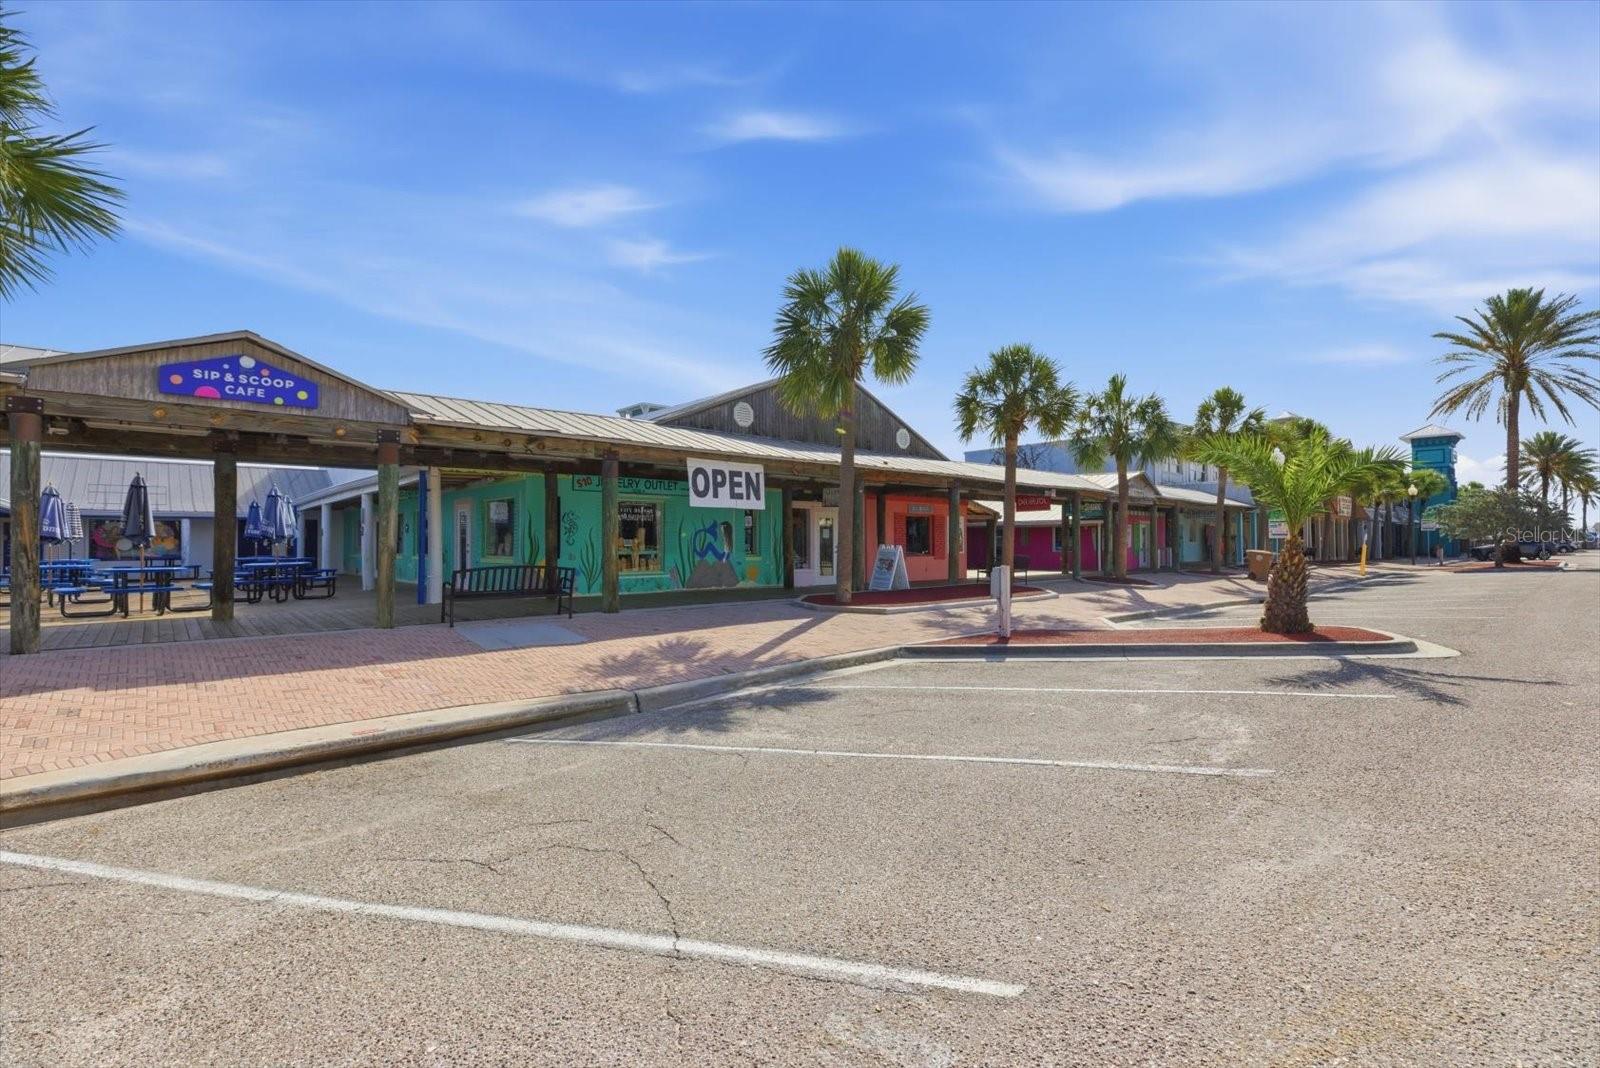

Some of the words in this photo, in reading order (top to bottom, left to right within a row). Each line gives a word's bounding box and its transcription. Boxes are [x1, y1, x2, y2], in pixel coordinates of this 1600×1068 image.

[192, 368, 220, 381] SIP
[224, 372, 235, 382] &
[238, 374, 295, 389] SCOOP
[224, 385, 266, 398] CAFE
[643, 479, 679, 491] OUTLET
[691, 466, 762, 501] OPEN
